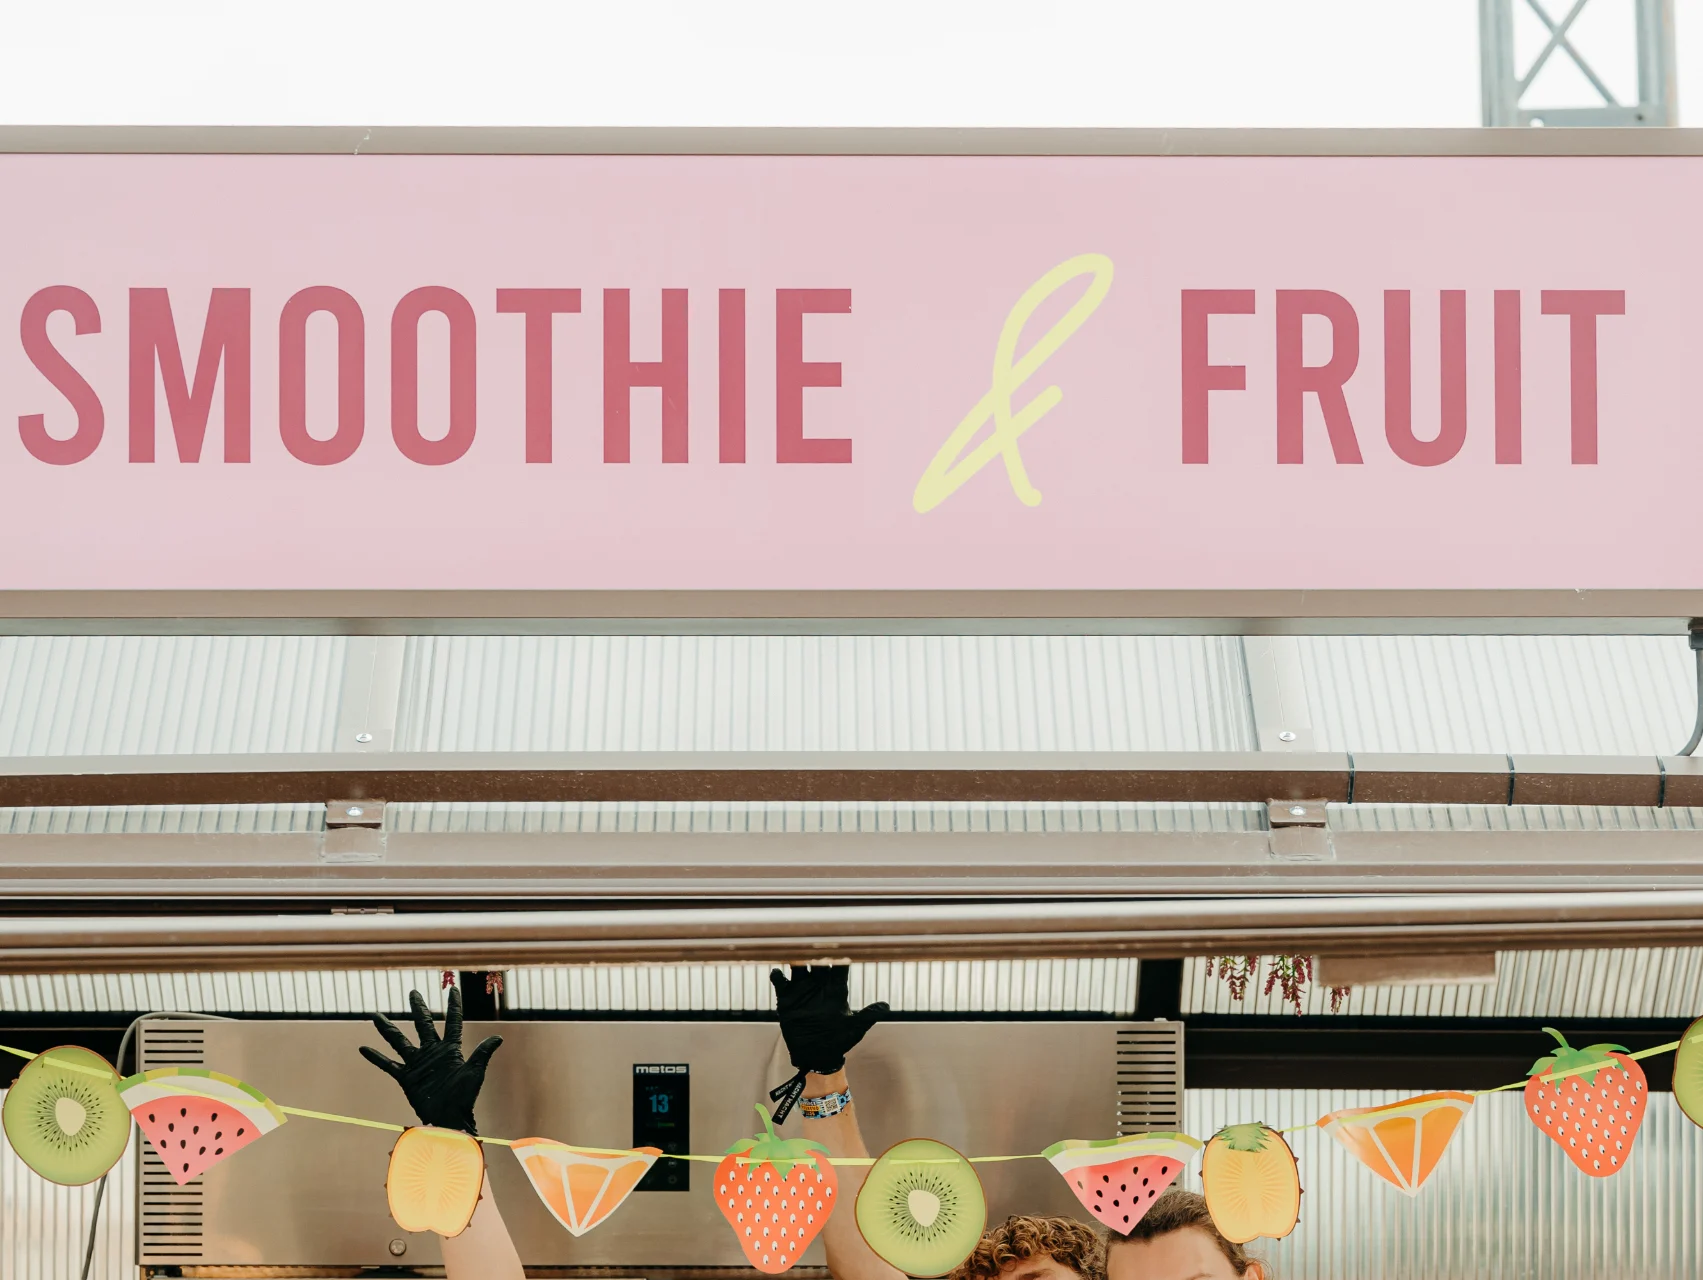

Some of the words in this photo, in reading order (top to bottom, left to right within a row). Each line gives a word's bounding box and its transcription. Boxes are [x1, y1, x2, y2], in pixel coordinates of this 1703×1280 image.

[17, 284, 853, 466] SMOOTHIE
[912, 254, 1114, 514] &
[1181, 289, 1626, 468] FRUIT
[635, 1065, 687, 1074] metos
[649, 1094, 669, 1113] 13
